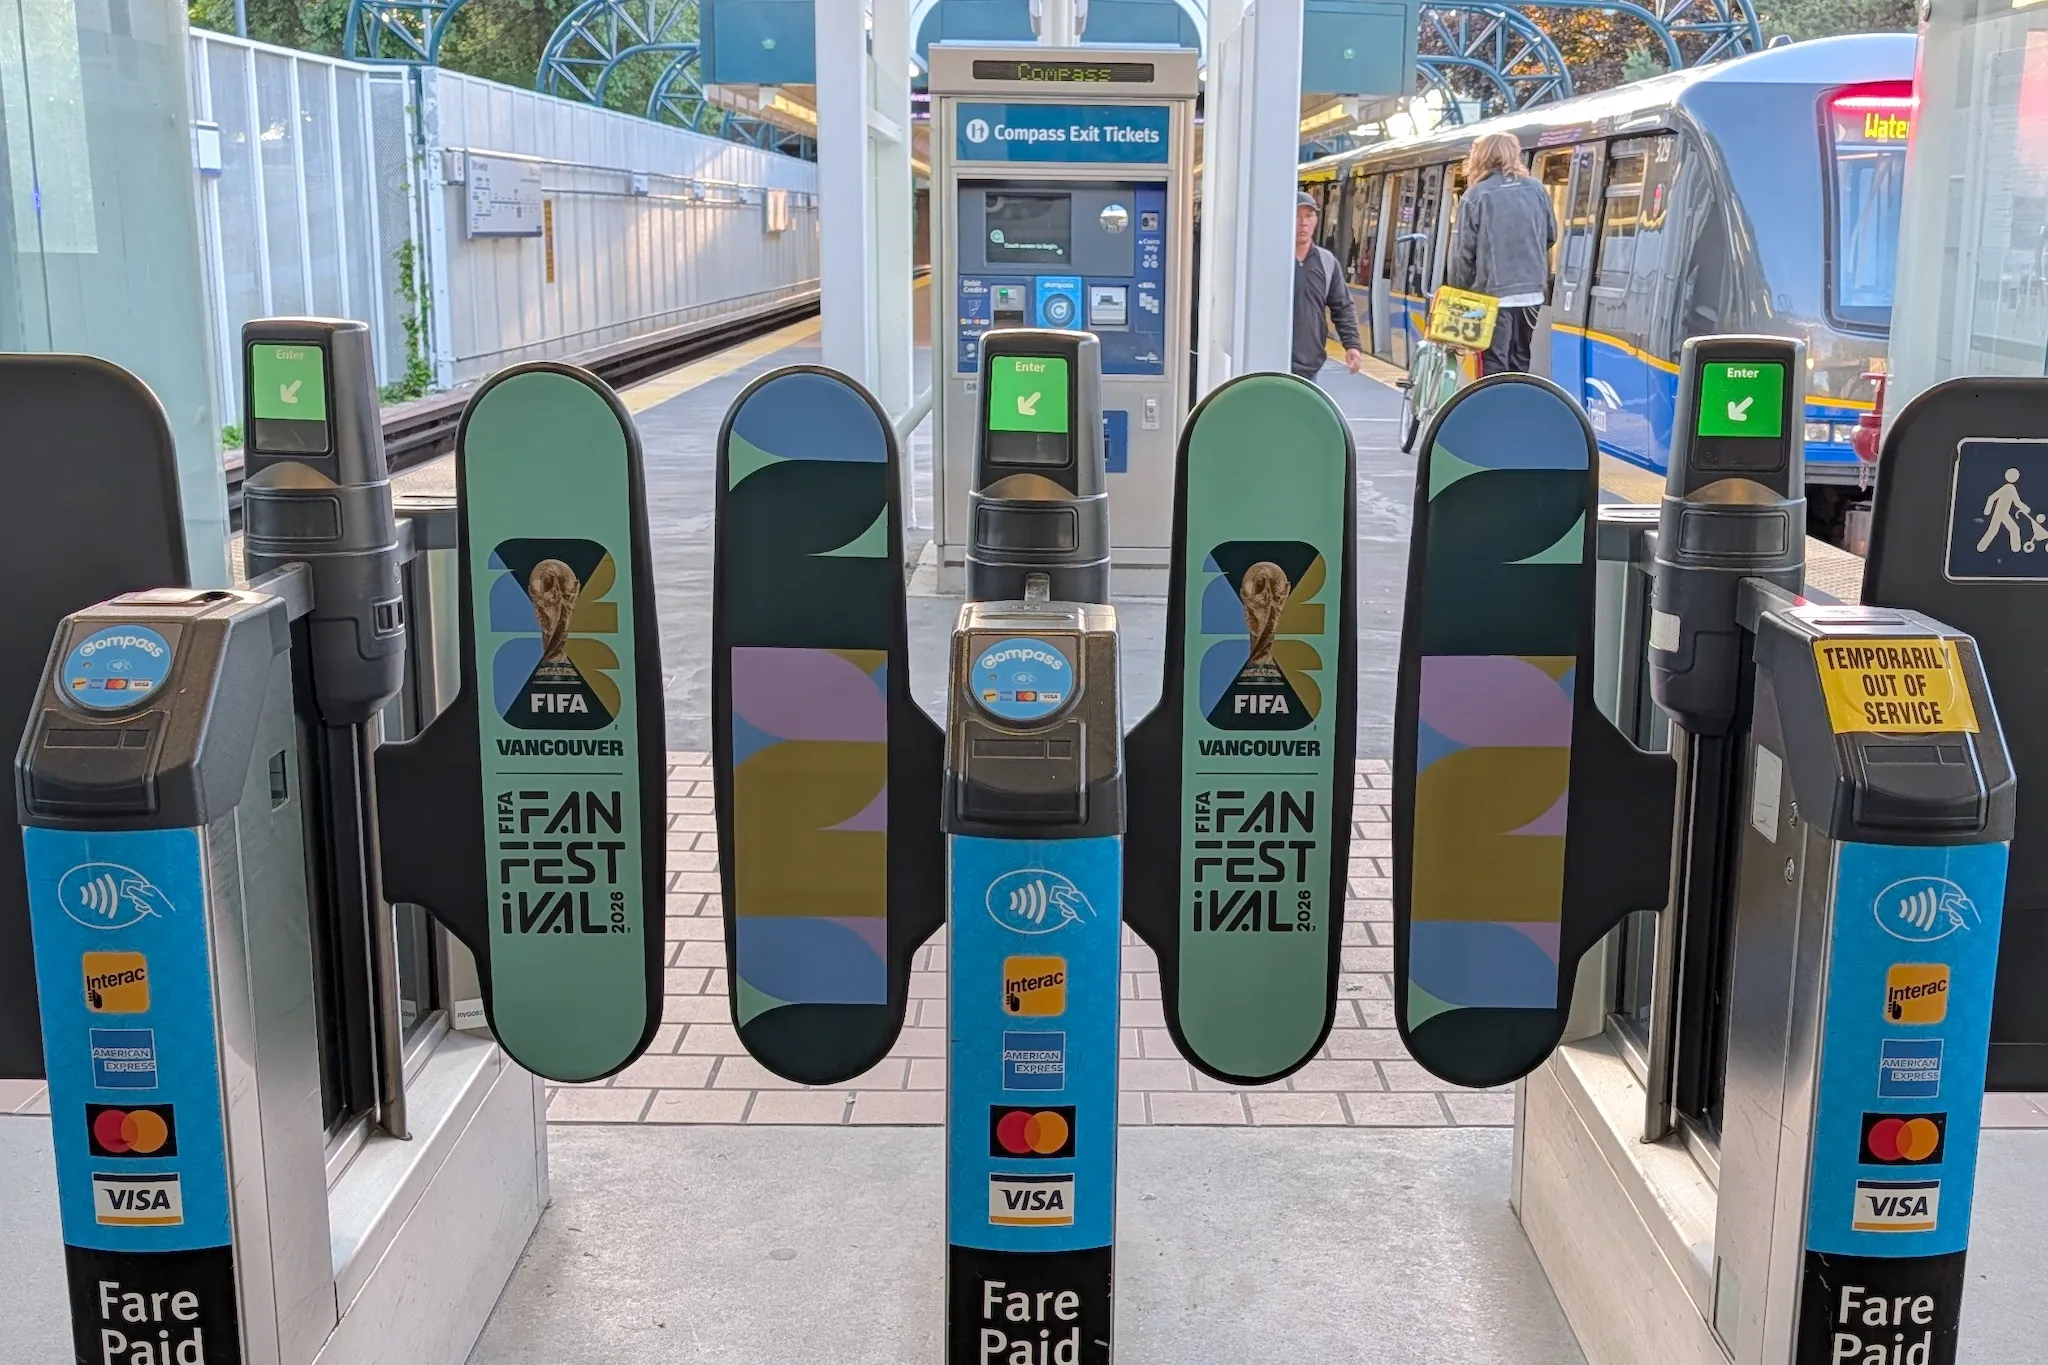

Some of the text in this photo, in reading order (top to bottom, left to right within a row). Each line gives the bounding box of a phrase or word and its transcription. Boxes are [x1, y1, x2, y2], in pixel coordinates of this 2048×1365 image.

[1017, 63, 1112, 82] Compass
[994, 124, 1160, 144] Compass Exit Tickets
[276, 350, 305, 361] Enter
[1015, 361, 1046, 373] Enter
[1727, 367, 1760, 379] Enter
[1862, 674, 1927, 697] OUT OF
[530, 693, 589, 713] FIFA
[1234, 694, 1289, 714] FIFA
[1863, 701, 1944, 725] SERVICE
[496, 739, 624, 756] VANCOUVER
[1199, 740, 1321, 756] VANCOUVER
[497, 790, 514, 834] FIFA
[519, 791, 621, 834] FAN
[1195, 790, 1211, 833] FIFA
[1216, 791, 1315, 833] FAN
[499, 841, 626, 884] FEST
[1194, 840, 1316, 882] FEST
[610, 891, 625, 934] 2026
[1297, 890, 1311, 932] 2026
[86, 967, 145, 991] Interac
[1006, 972, 1064, 994] Interac
[1889, 979, 1947, 1003] Interac
[93, 1049, 149, 1058] AMERICAN
[1005, 1051, 1059, 1060] AMERICAN
[1882, 1059, 1937, 1067] AMERICAN
[106, 1062, 155, 1070] EXPRESS
[1016, 1064, 1064, 1073] EXPRESS
[1893, 1072, 1940, 1080] EXPRESS
[103, 1189, 171, 1210] VISA
[999, 1189, 1064, 1211] VISA
[1865, 1195, 1928, 1217] VISA
[98, 1280, 199, 1323] Fare
[983, 1280, 1080, 1322] Fare
[1839, 1285, 1935, 1327] Fare
[101, 1327, 205, 1365] Paid
[980, 1327, 1080, 1365] Paid
[1832, 1330, 1932, 1365] Paid
